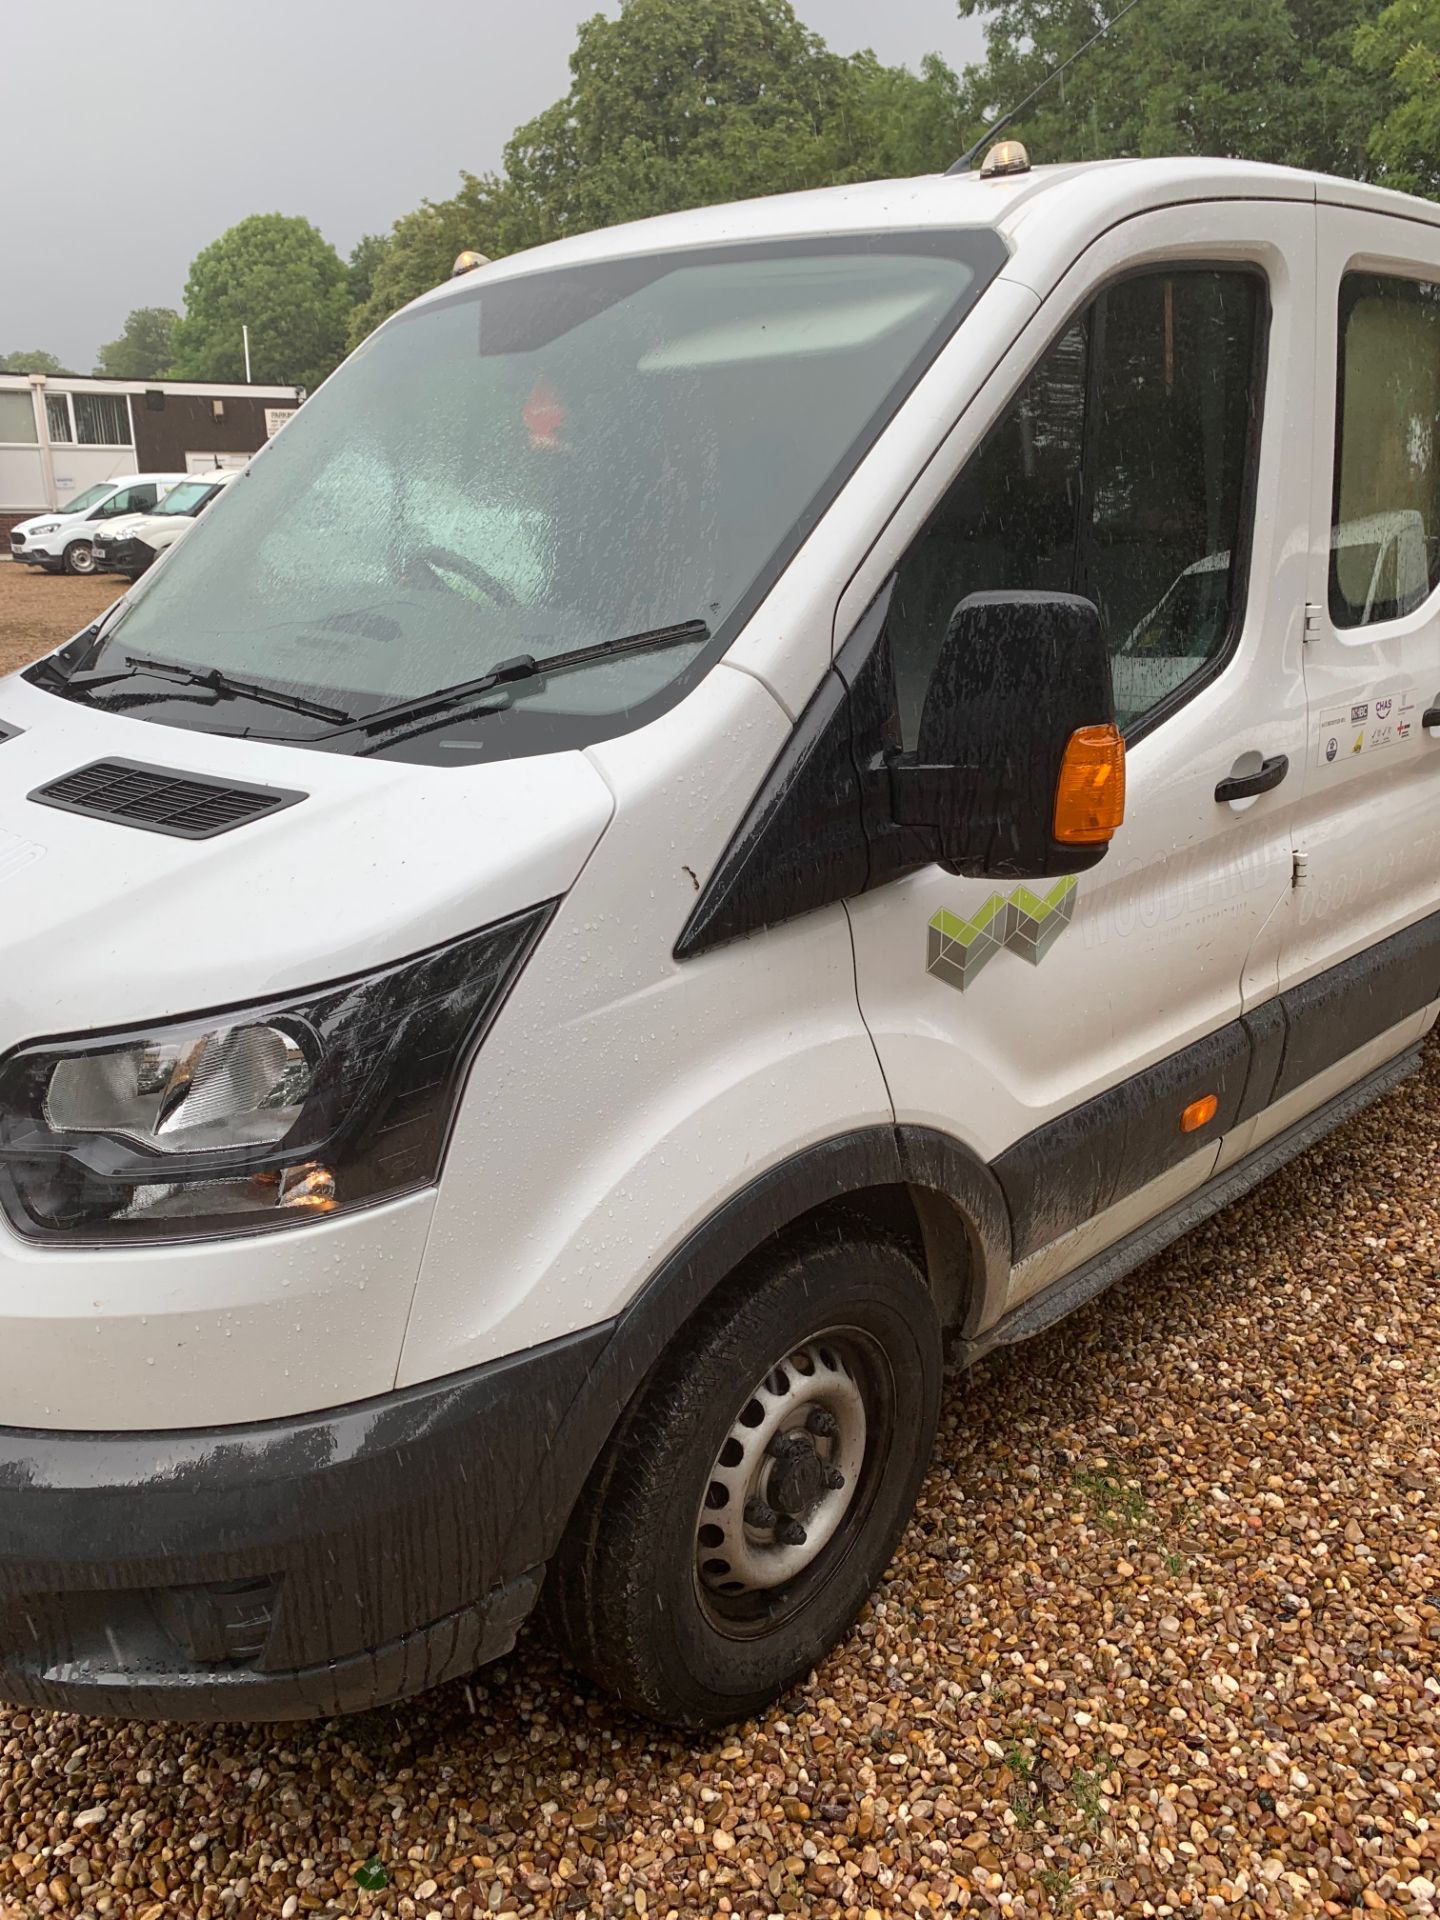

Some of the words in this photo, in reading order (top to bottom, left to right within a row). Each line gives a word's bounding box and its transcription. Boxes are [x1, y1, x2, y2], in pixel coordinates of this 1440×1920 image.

[271, 411, 294, 419] PARKIN
[1375, 699, 1392, 711] CHAS
[1080, 824, 1272, 950] WOODLAND
